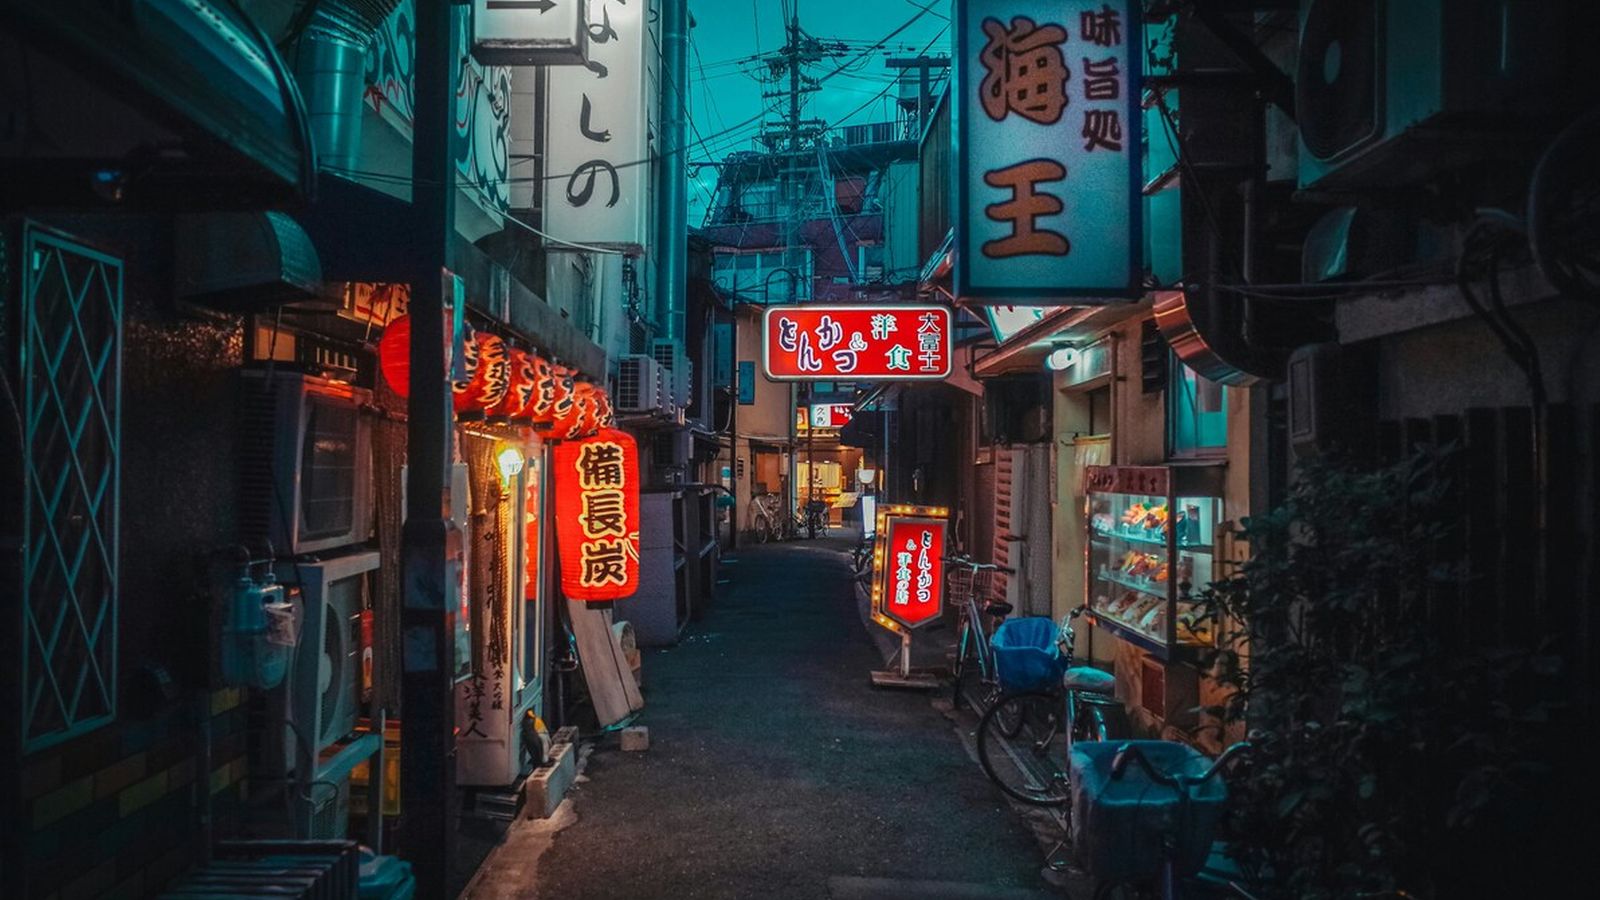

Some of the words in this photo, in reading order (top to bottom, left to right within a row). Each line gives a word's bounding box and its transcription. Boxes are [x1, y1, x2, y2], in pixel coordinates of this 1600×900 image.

[1079, 4, 1122, 152] 味旨処
[979, 15, 1071, 258] 海王
[779, 315, 858, 372] とんかつ
[870, 313, 913, 371] 洋食
[917, 312, 941, 372] 大富士
[577, 441, 628, 587] 備長炭
[916, 530, 932, 603] とんかつ
